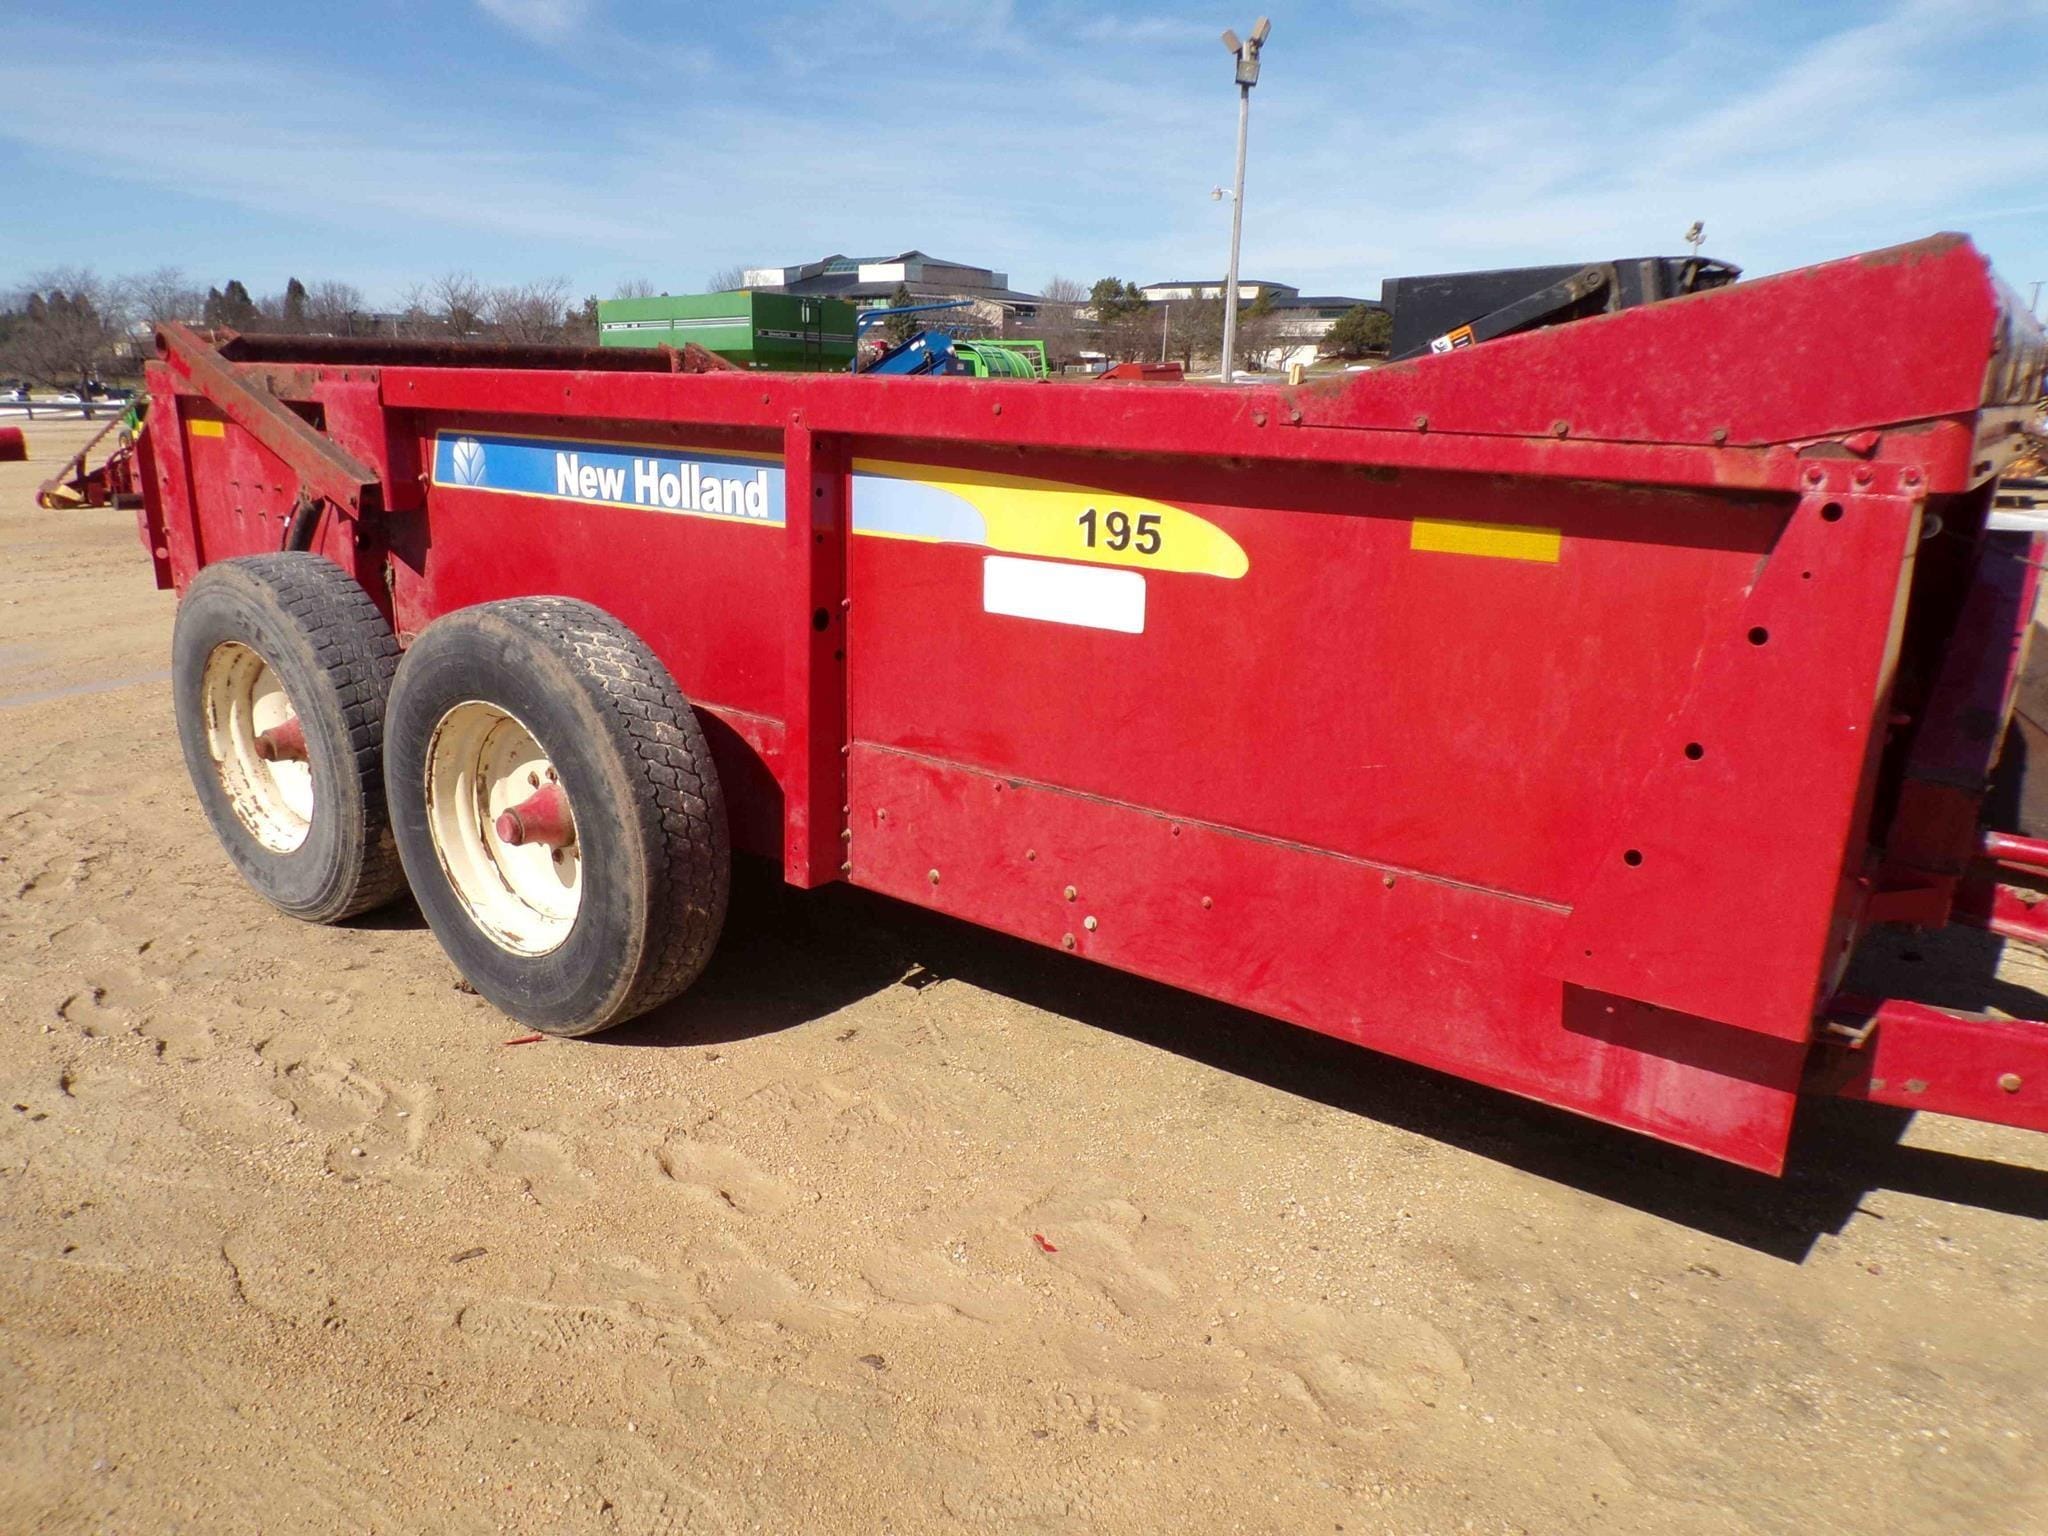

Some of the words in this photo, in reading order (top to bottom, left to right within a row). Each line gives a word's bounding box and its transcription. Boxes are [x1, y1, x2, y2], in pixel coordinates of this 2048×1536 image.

[556, 453, 625, 501] New
[634, 459, 768, 518] Holland
[1078, 508, 1162, 555] 195
